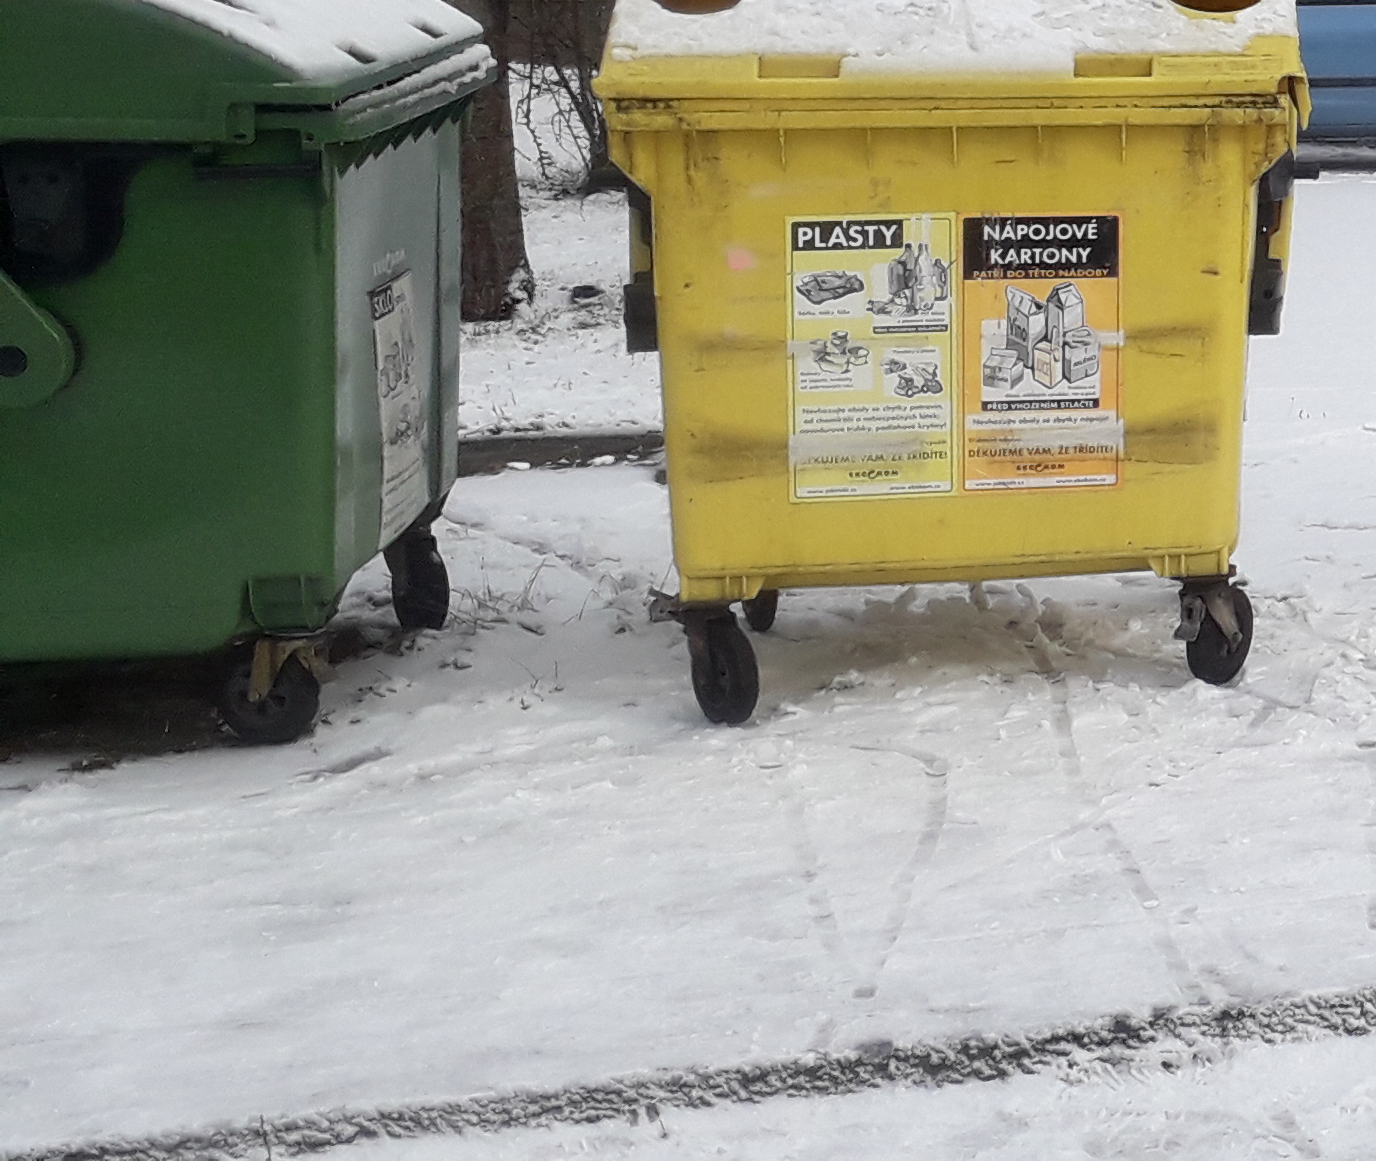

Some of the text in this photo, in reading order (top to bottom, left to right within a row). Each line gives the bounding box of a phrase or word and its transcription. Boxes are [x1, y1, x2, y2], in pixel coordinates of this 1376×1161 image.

[797, 224, 899, 248] PLASTY
[983, 219, 1099, 241] NÁPOJOVÉ
[990, 247, 1092, 265] KARTONY
[973, 267, 1110, 279] PATŘÍ DO TÉTO NÁDOBY
[1058, 443, 1070, 455] ŽE
